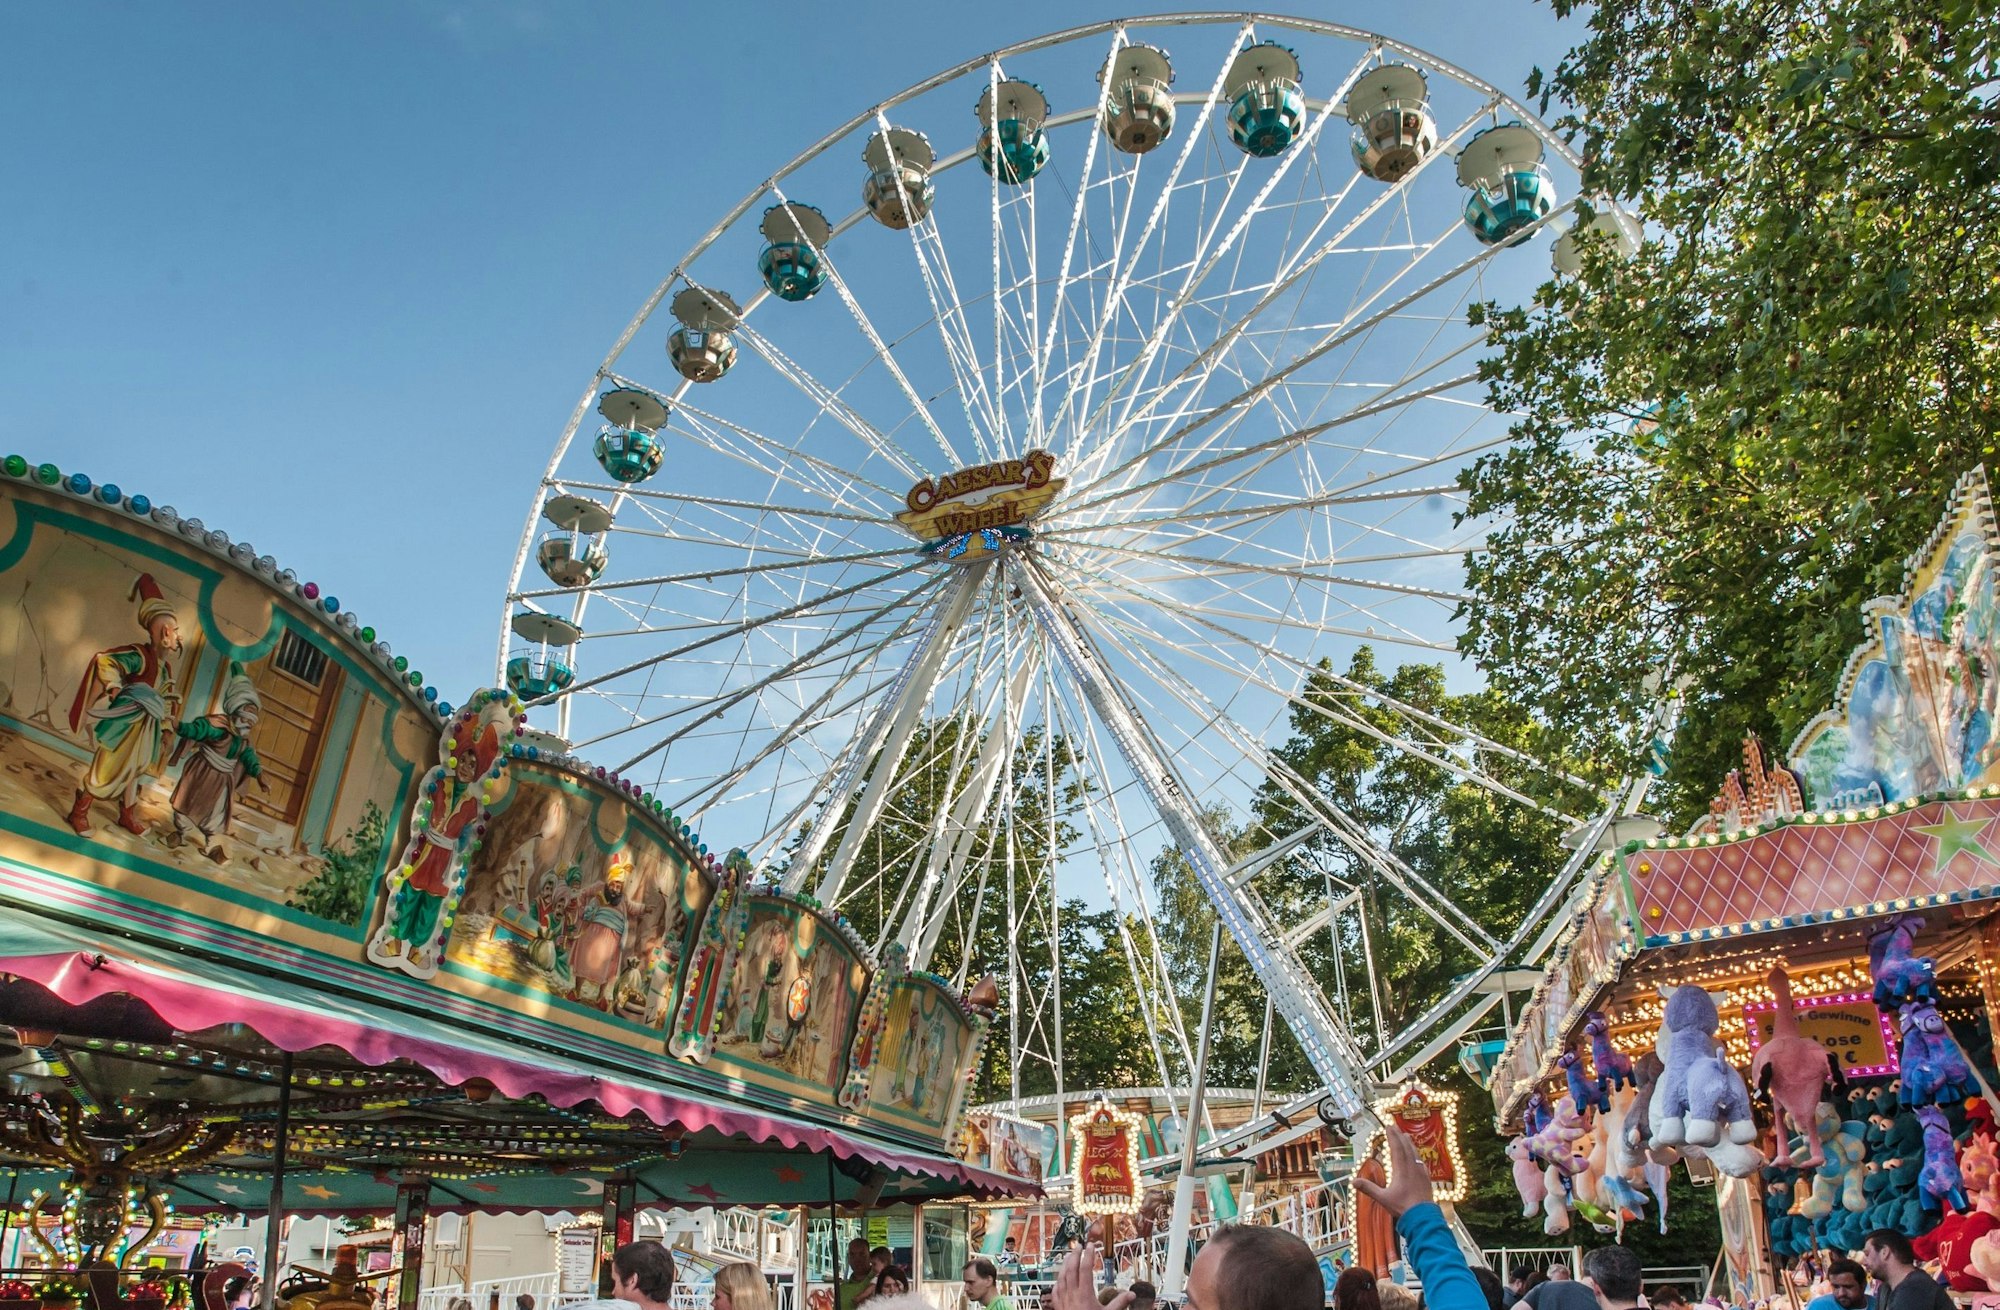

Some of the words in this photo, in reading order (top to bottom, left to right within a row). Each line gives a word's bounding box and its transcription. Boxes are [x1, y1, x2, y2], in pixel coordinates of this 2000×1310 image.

[934, 502, 1026, 536] WHEEL
[1808, 1010, 1871, 1026] Gewinne
[1812, 1035, 1861, 1047] ose
